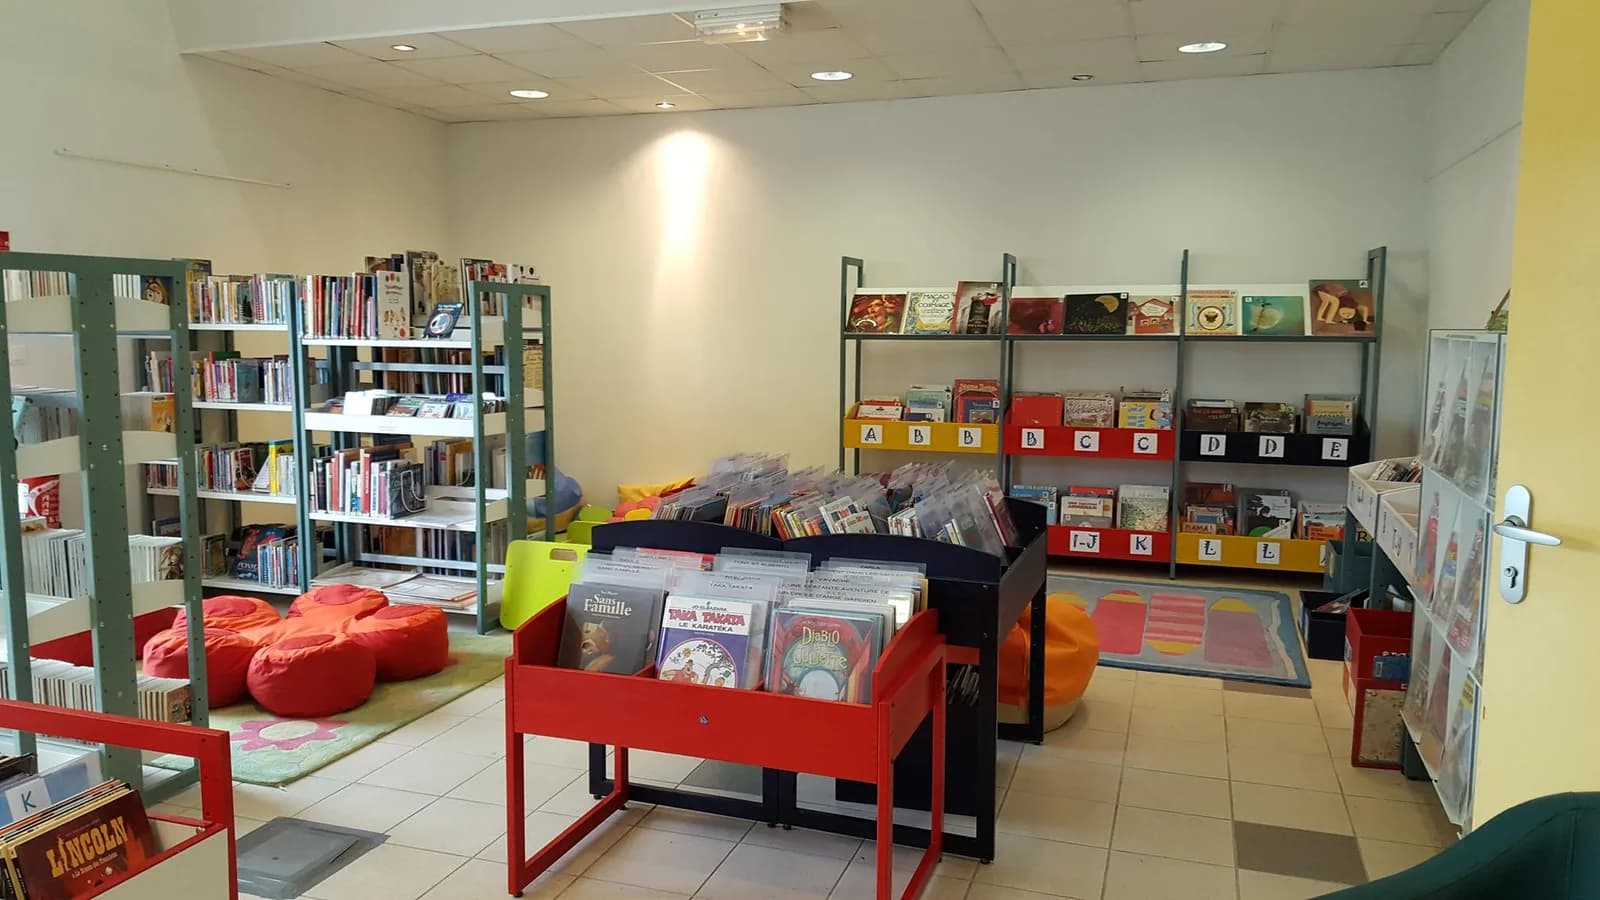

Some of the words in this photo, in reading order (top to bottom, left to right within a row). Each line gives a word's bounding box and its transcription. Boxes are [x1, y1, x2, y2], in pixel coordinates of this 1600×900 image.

[864, 427, 877, 441] A
[914, 428, 924, 443] B
[963, 430, 974, 445] B
[1027, 431, 1037, 446] B
[1079, 435, 1091, 448] C
[1137, 436, 1149, 451] C
[1207, 436, 1220, 452] D
[1264, 438, 1277, 455] D
[1330, 441, 1342, 457] E
[1135, 535, 1147, 551] K
[1203, 540, 1216, 556] L
[1262, 543, 1275, 559] L
[594, 593, 616, 605] Sans
[583, 599, 632, 616] Famille
[668, 608, 698, 621] TAKA
[702, 611, 745, 626] TAKATA
[20, 790, 37, 812] K
[45, 815, 128, 879] LINCOLN
